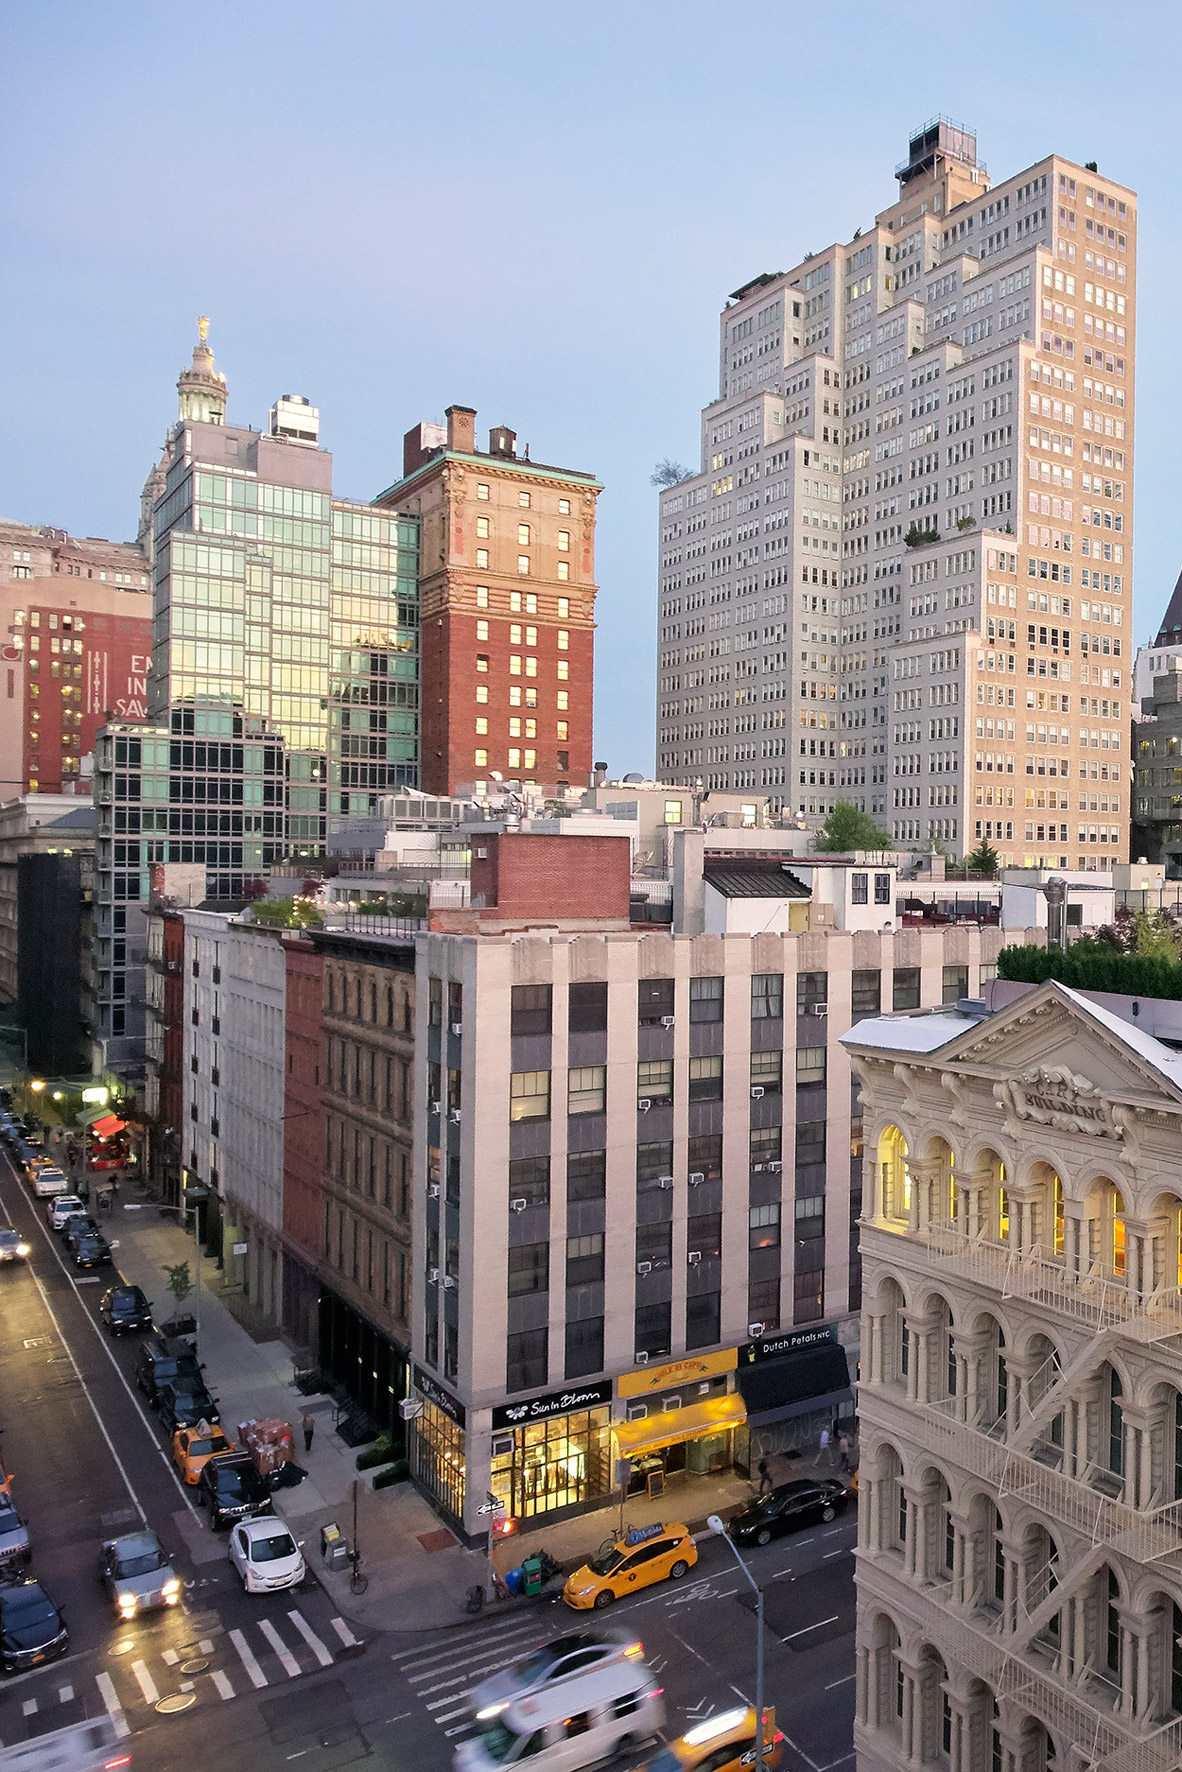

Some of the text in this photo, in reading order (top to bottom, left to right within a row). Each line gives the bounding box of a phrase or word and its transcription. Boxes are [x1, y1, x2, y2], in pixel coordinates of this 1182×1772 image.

[128, 677, 147, 696] IN
[1025, 1093, 1106, 1122] BUILDING
[763, 1339, 789, 1353] Dutch
[791, 1333, 817, 1345] Petals
[817, 1330, 830, 1340] NYC
[530, 1392, 600, 1415] Sun In Bloom
